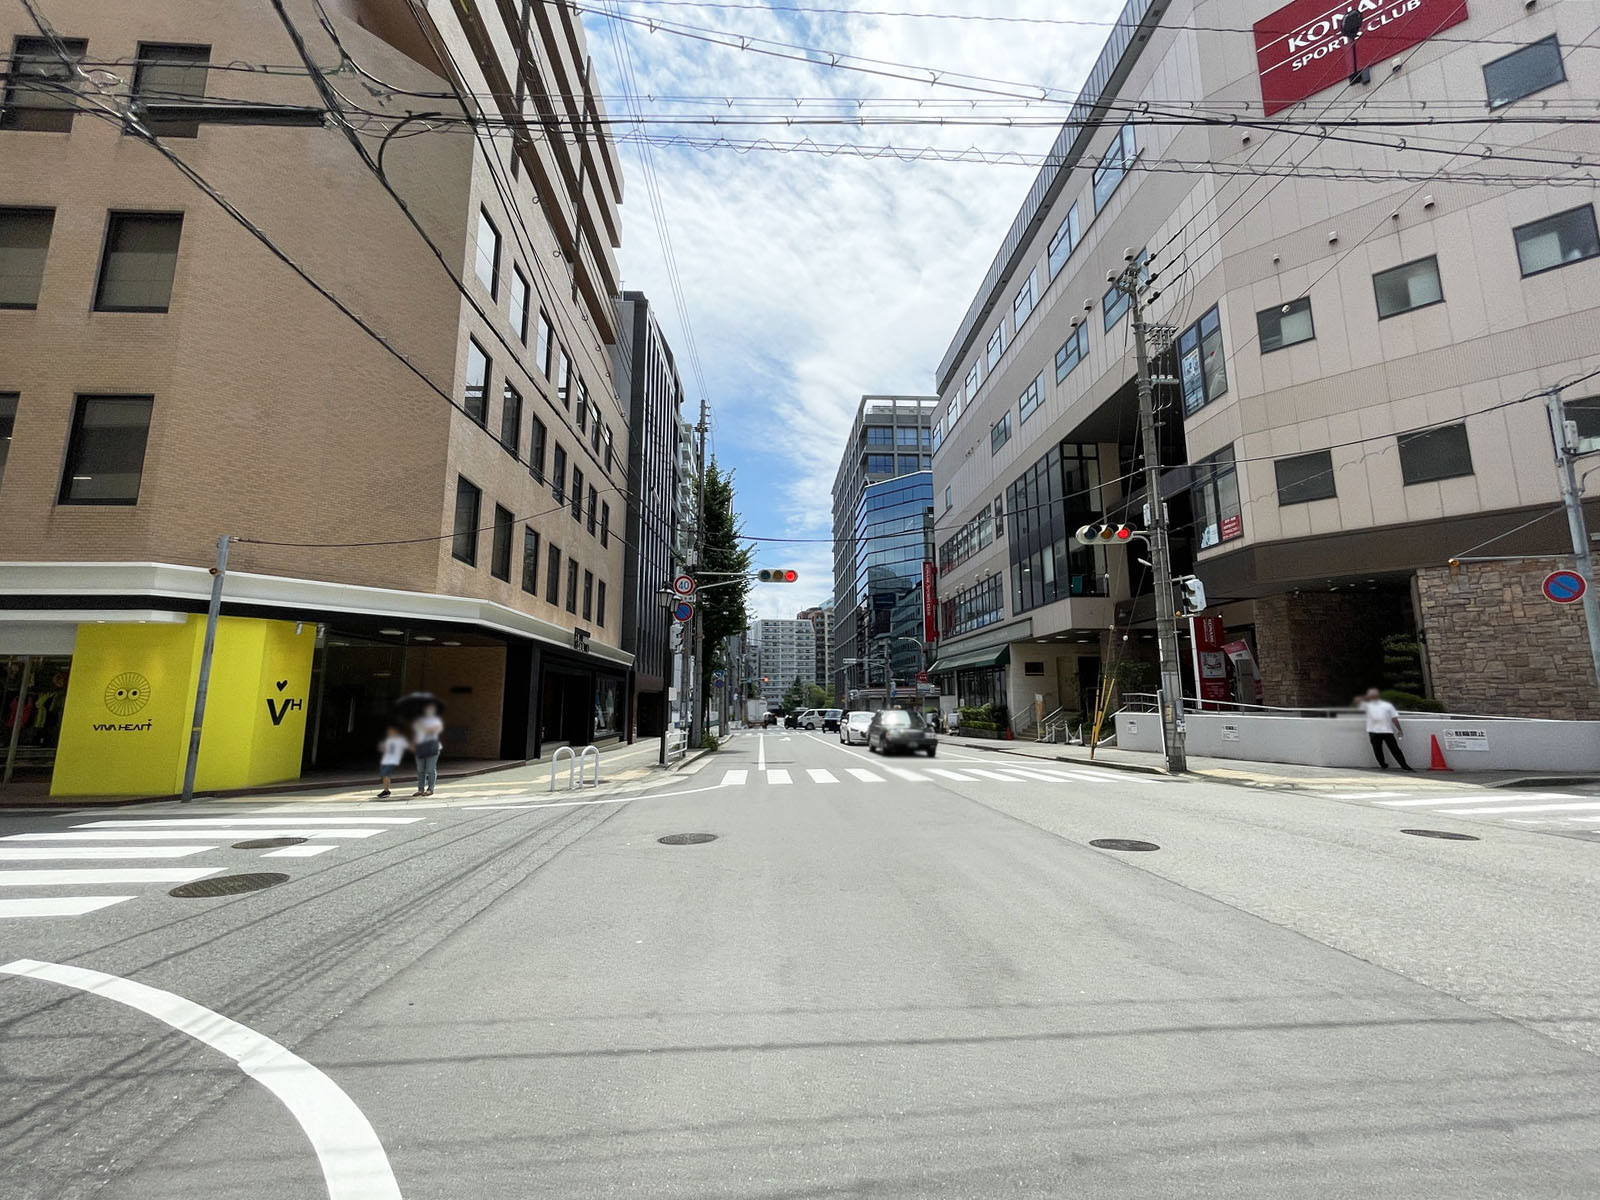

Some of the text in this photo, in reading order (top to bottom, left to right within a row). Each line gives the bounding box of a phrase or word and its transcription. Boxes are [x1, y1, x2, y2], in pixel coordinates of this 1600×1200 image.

[1287, 0, 1384, 53] KONA
[1367, 0, 1422, 32] CLUB
[678, 581, 690, 590] 40
